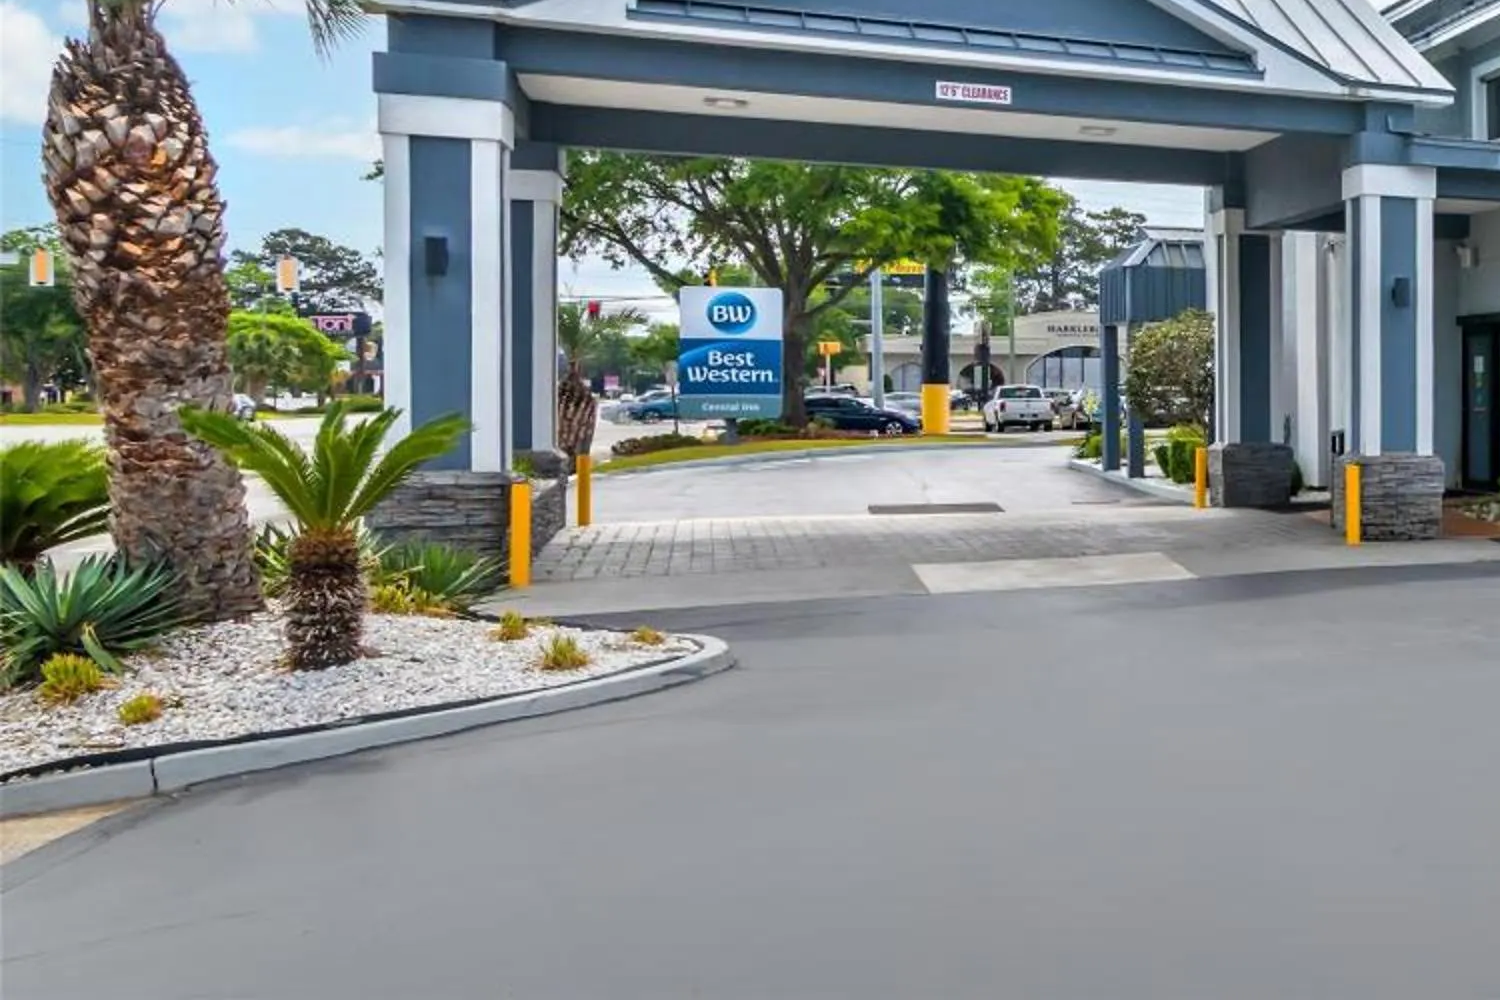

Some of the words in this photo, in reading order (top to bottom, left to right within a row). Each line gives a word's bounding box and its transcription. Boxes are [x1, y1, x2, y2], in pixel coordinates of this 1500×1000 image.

[961, 86, 1009, 101] CLEARANCE
[713, 305, 752, 323] BW
[708, 350, 755, 367] Best
[687, 366, 774, 382] Western
